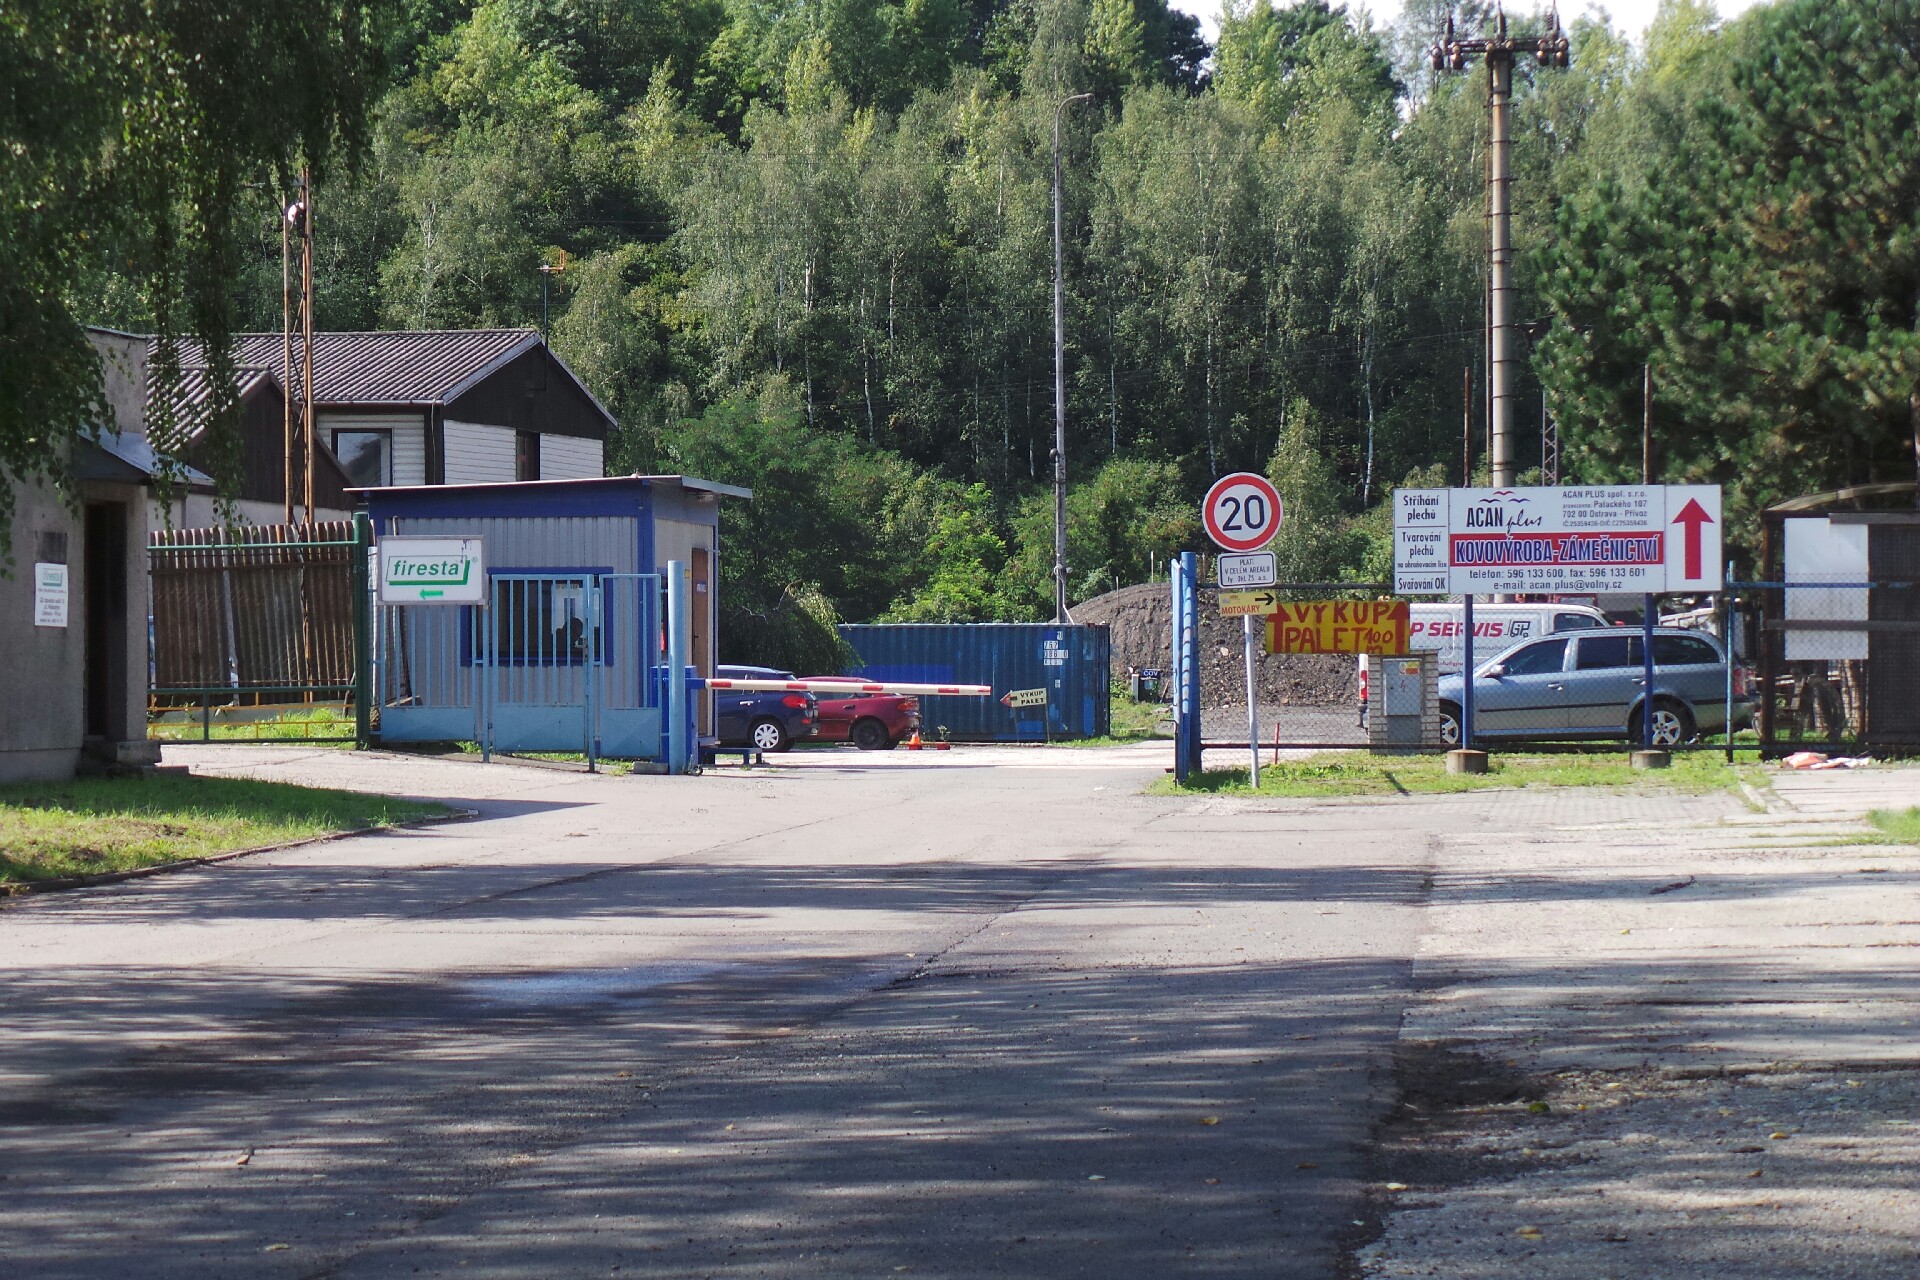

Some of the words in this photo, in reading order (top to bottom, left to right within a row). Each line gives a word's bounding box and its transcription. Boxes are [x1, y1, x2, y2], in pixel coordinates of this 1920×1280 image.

[1403, 495, 1440, 506] Stříhání
[1562, 490, 1583, 498] ACAN
[1585, 490, 1605, 498] PLUS
[1607, 490, 1625, 499] spol.
[1593, 500, 1631, 508] Palackého
[1220, 494, 1265, 532] 20
[1407, 508, 1436, 523] plechů
[1589, 509, 1617, 517] Ostrava
[1467, 507, 1503, 527] ACAN
[1506, 509, 1542, 536] plus
[1402, 531, 1442, 542] Tvarování
[1410, 544, 1434, 559] plechů
[1455, 536, 1659, 563] KOVOVÝROBA-ZÁMEČNICTVÍ
[394, 560, 459, 576] firesta
[1469, 569, 1504, 578] telefon:
[1507, 569, 1524, 578] 596
[1527, 569, 1544, 578] 133
[1569, 568, 1586, 577] fax:
[1589, 568, 1606, 577] 596
[1610, 567, 1626, 577] 133
[1629, 567, 1646, 577] 601
[1398, 577, 1434, 591] Svařování
[1434, 577, 1446, 590] OK
[1493, 580, 1526, 590] e-mail:
[1529, 580, 1622, 591] acan.plus@volny.cz
[1284, 626, 1370, 653] PALET
[1021, 697, 1045, 705] PALET
